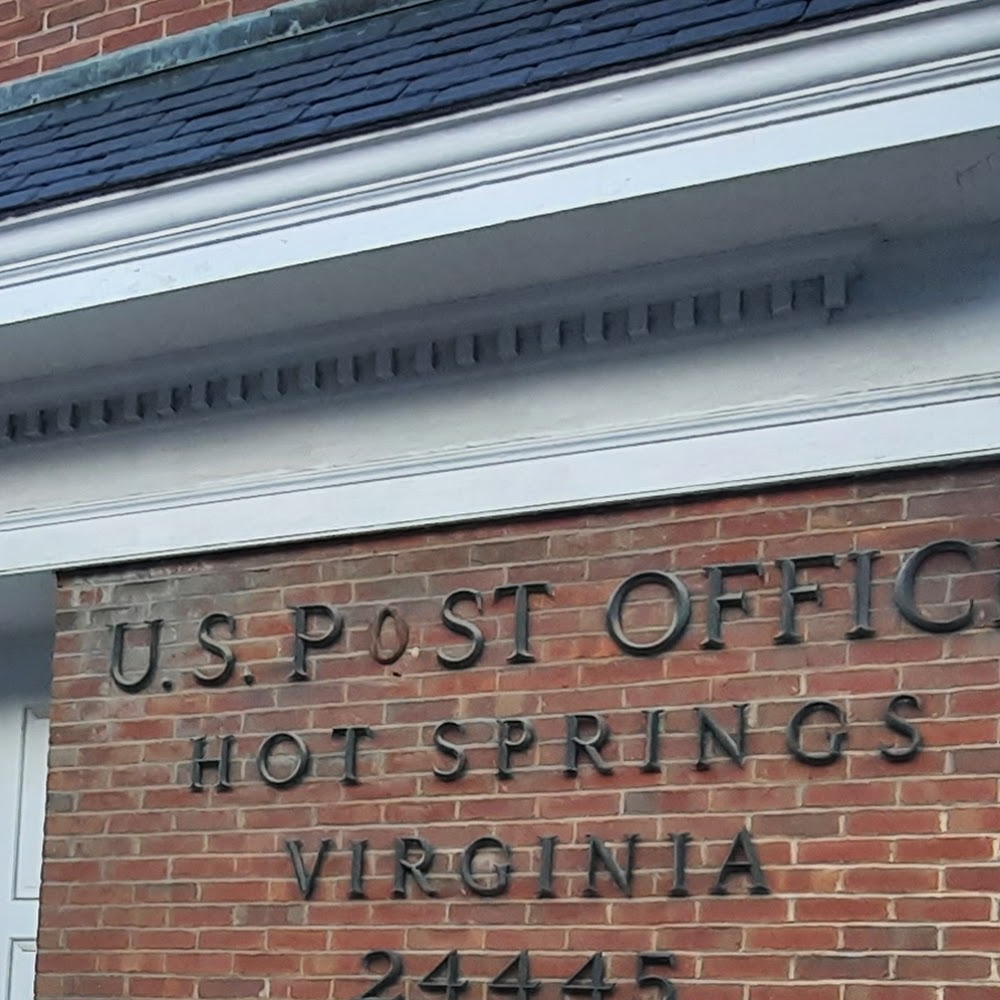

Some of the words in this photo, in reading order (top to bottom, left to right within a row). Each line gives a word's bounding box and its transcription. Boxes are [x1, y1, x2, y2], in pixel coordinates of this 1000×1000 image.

[289, 583, 554, 682] POST
[606, 539, 1000, 656] OFFIC
[189, 726, 373, 792] HOT
[432, 694, 923, 782] SPRINGS
[284, 829, 771, 900] VIRGINIA
